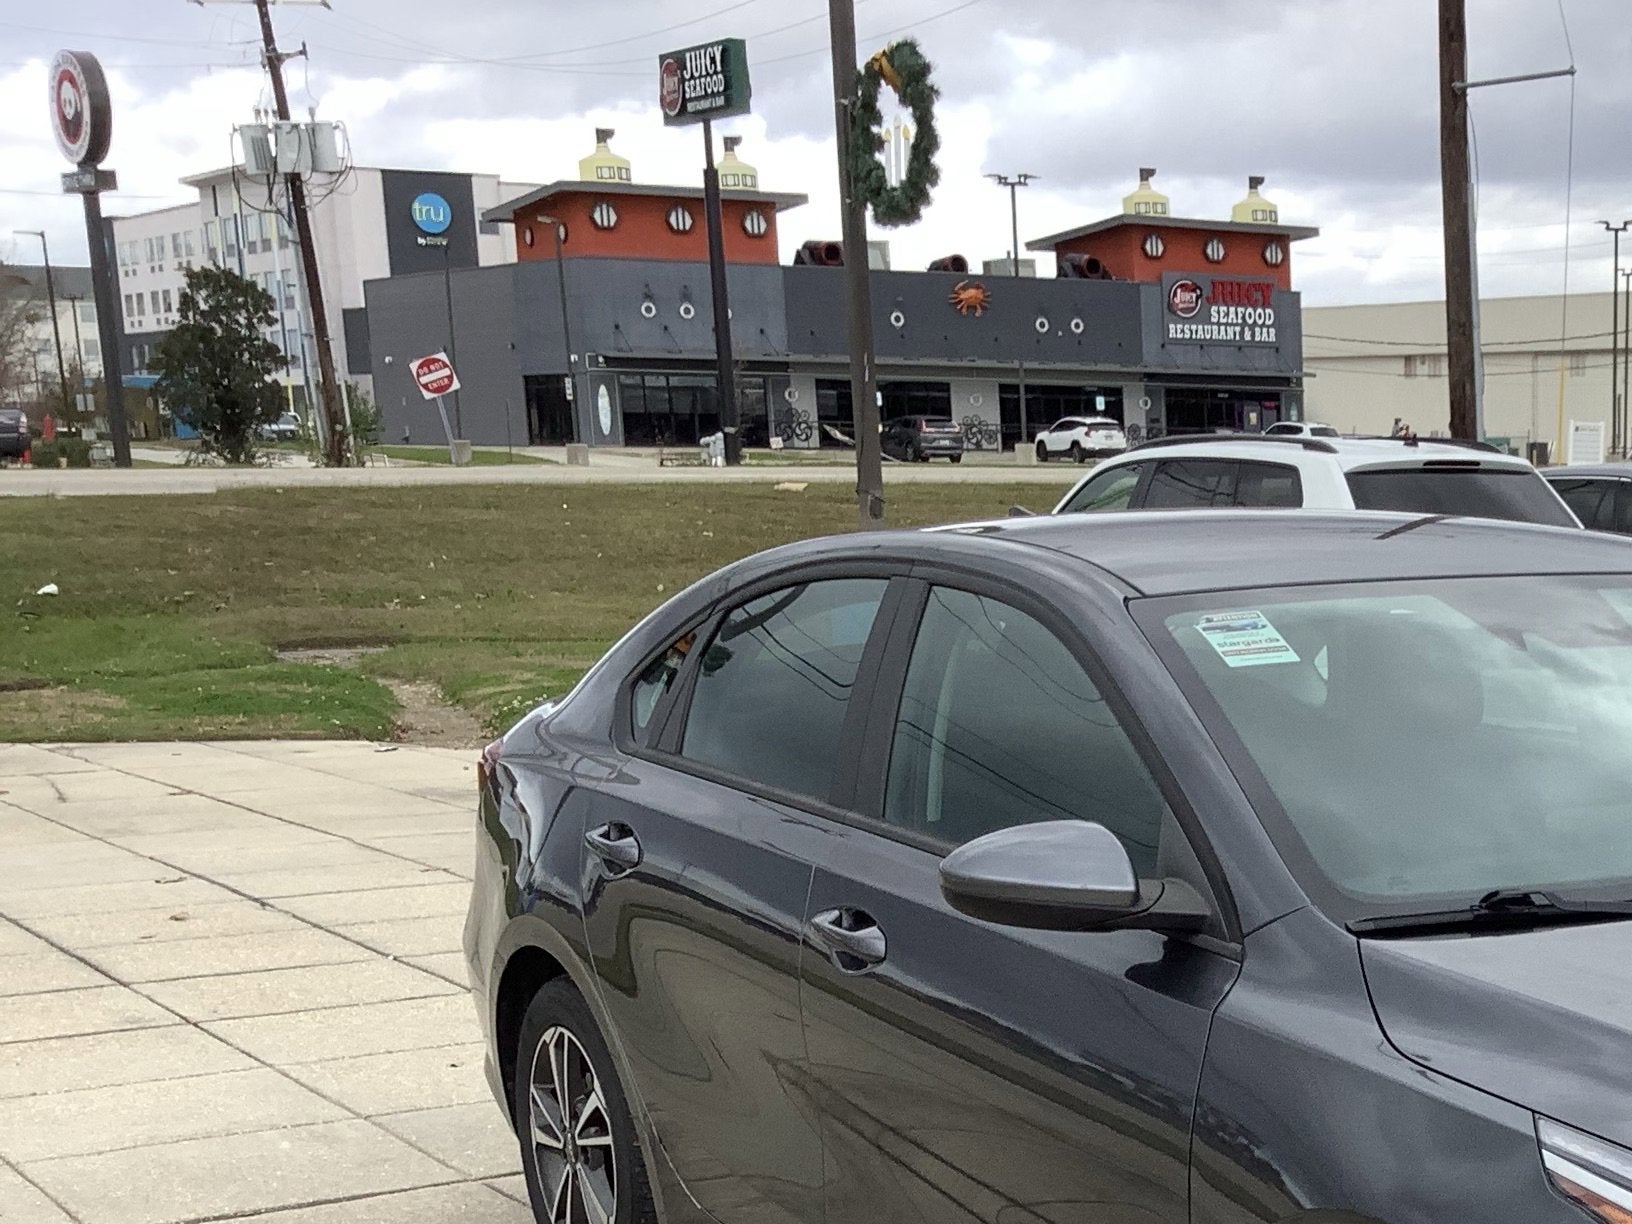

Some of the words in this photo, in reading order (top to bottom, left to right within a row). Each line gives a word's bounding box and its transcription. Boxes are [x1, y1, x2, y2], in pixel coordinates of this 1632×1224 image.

[683, 45, 722, 79] JUICY
[684, 73, 725, 99] SEAFOOD
[412, 202, 444, 222] tru
[1205, 279, 1274, 306] JUICY
[1210, 305, 1275, 325] SEAFOOD
[1168, 323, 1241, 340] RESTAURANT
[1243, 326, 1252, 341] &
[1254, 327, 1276, 342] BAR
[418, 366, 429, 376] DO
[429, 361, 444, 371] NOT
[427, 377, 450, 390] ENTER
